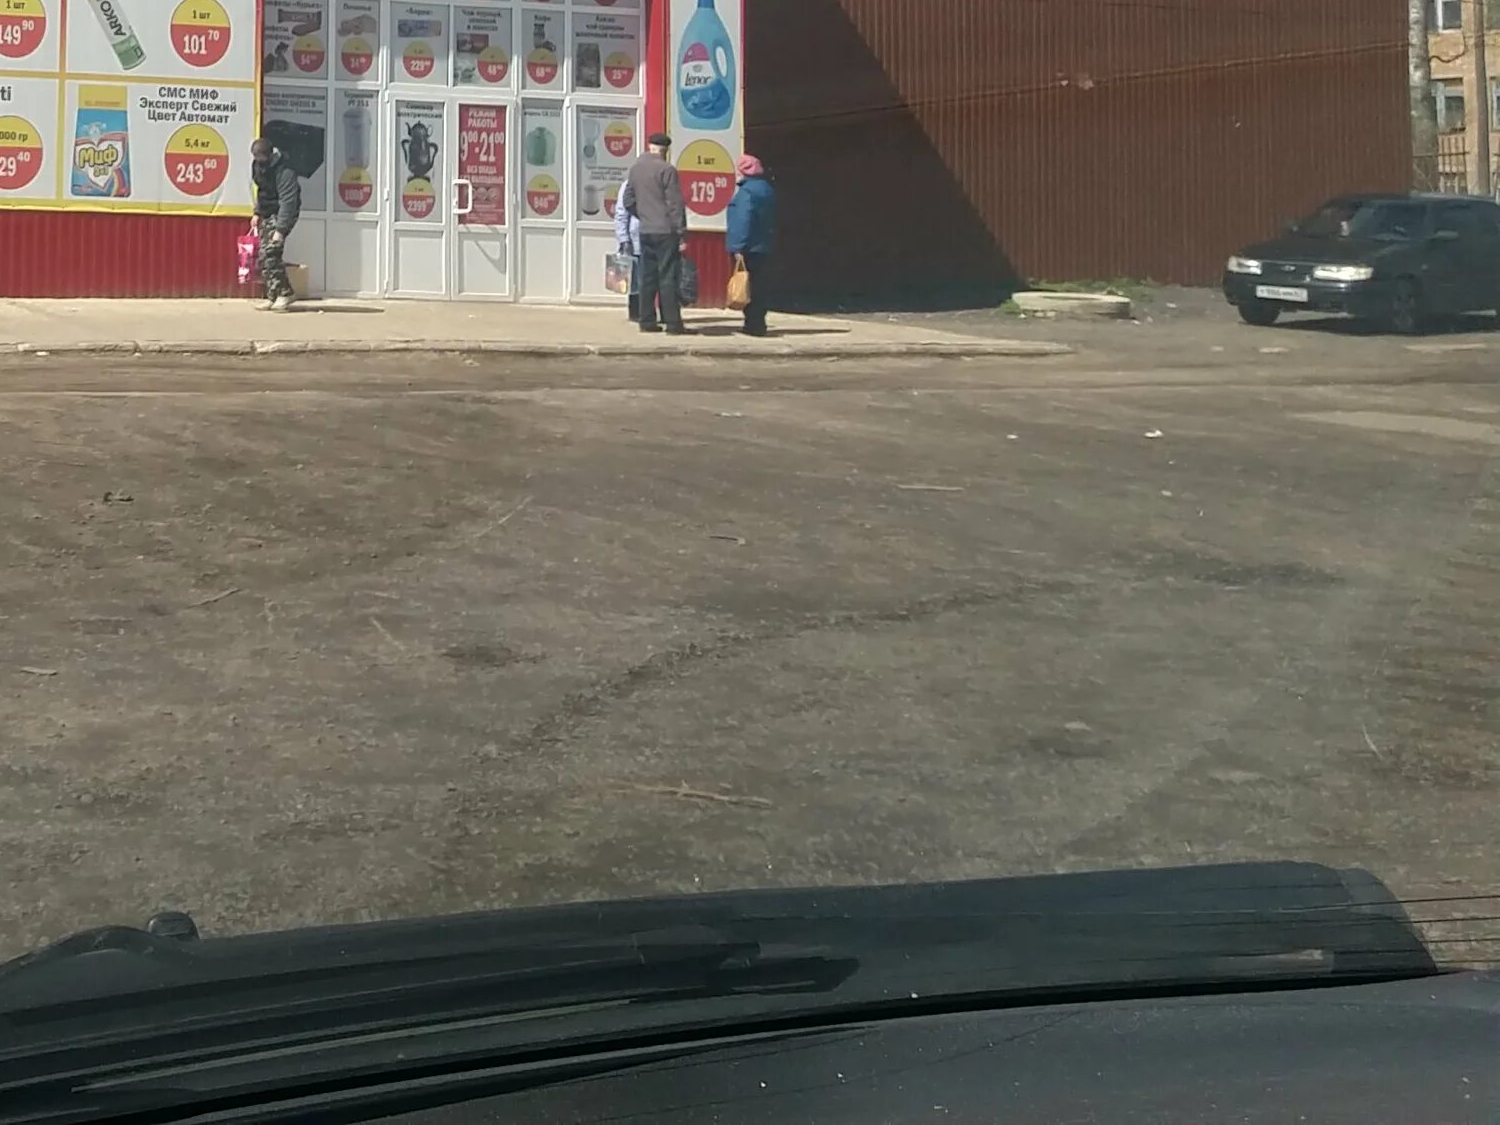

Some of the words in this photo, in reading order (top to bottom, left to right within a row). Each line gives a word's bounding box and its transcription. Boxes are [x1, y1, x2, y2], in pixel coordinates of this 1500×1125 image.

[13, 1, 25, 10] шт
[100, 0, 127, 36] ARKO
[198, 11, 210, 20] шт
[22, 20, 34, 31] 90
[183, 34, 207, 55] 101
[207, 30, 219, 41] 70
[685, 72, 711, 87] Lenor
[158, 87, 187, 98] СМС
[189, 88, 219, 100] МИФ
[139, 97, 188, 112] Эксперт
[191, 99, 237, 113] Свежий
[147, 110, 176, 123] Цвет
[179, 111, 229, 124] Автомат
[467, 117, 498, 128] РАБОТЫ
[18, 132, 28, 141] гр
[201, 140, 211, 150] кг
[17, 151, 31, 162] 40
[79, 144, 118, 169] Миф
[704, 156, 715, 165] шт
[176, 162, 204, 183] 243
[204, 158, 217, 170] 60
[690, 180, 715, 203] 179
[715, 176, 728, 188] 90
